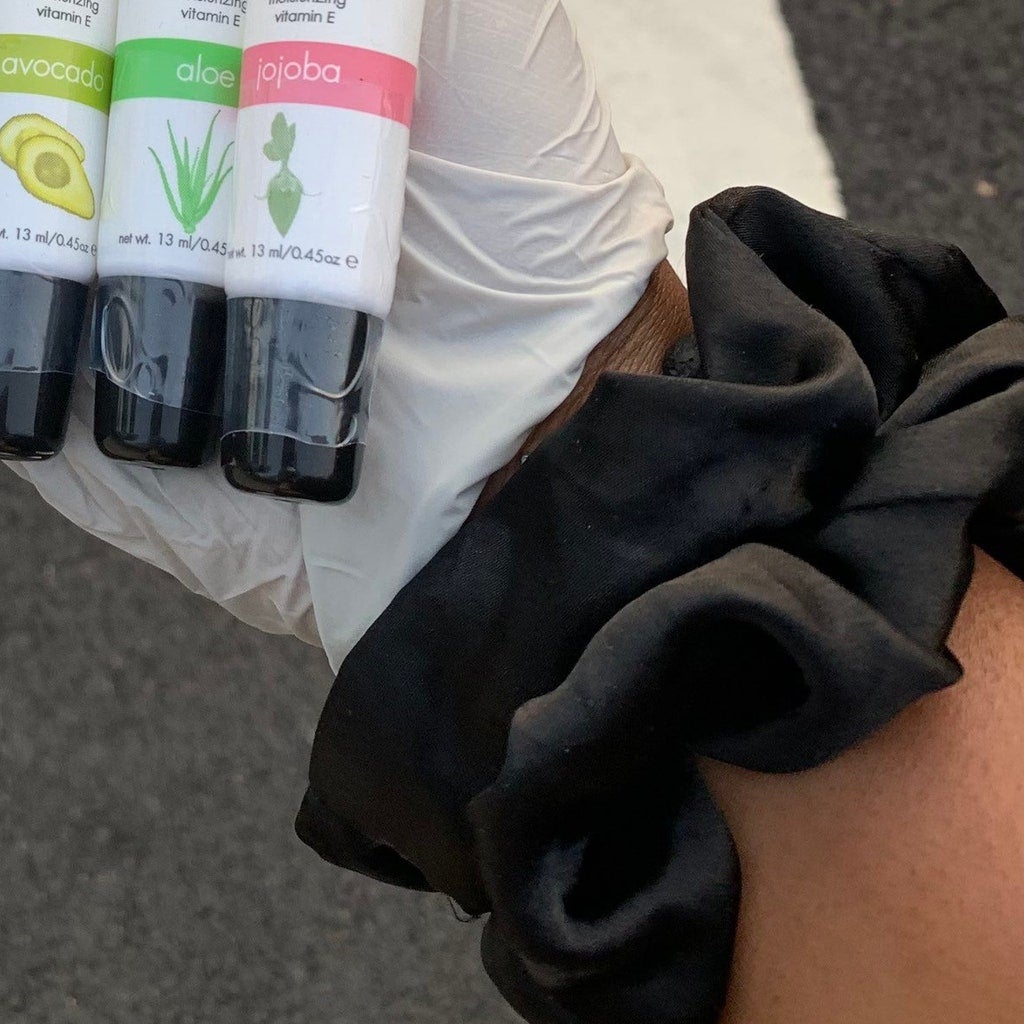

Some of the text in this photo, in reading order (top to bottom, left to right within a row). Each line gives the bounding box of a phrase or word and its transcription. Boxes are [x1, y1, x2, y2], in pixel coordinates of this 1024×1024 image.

[37, 6, 92, 28] vitamin E
[181, 7, 241, 27] vitamin E
[275, 10, 335, 24] vitamin E
[2, 56, 104, 92] avocado
[176, 54, 235, 89] aloe
[256, 51, 341, 91] jojoba
[15, 228, 31, 241] 13
[119, 232, 134, 245] net
[158, 233, 174, 246] 13
[178, 234, 227, 257] ml/0.45
[252, 244, 265, 257] 13
